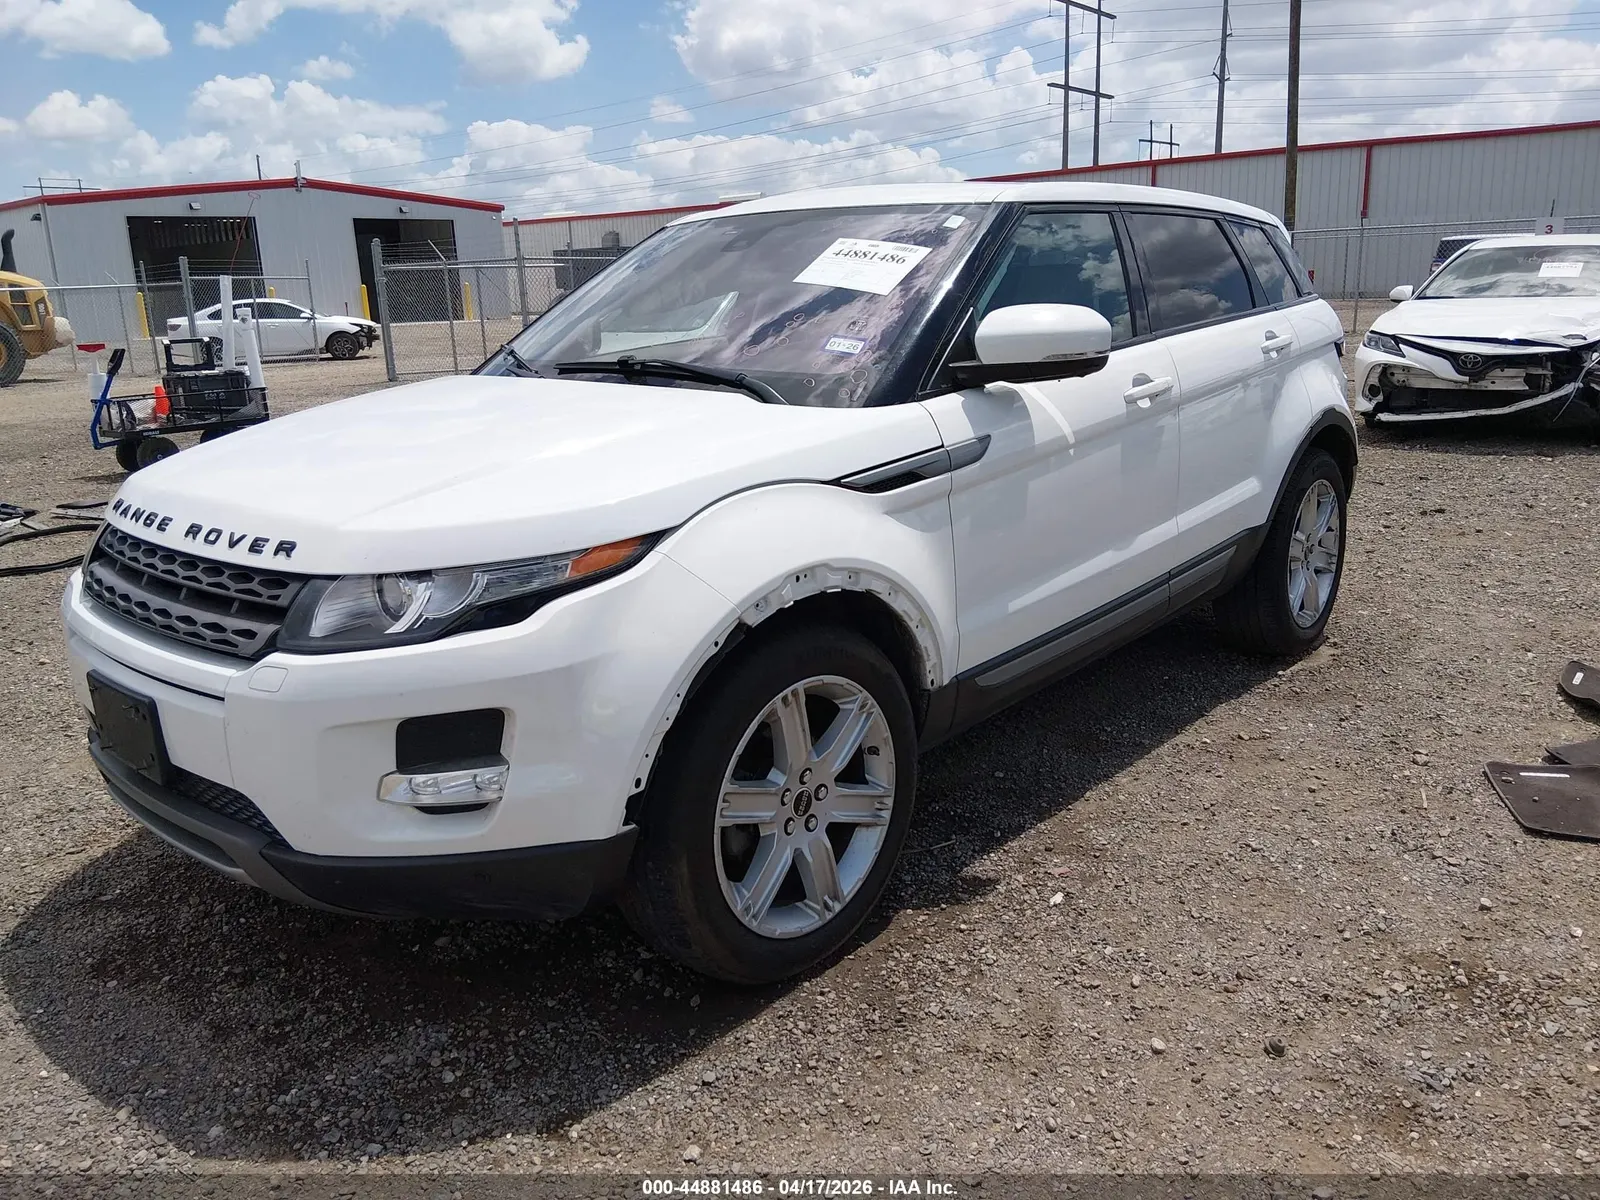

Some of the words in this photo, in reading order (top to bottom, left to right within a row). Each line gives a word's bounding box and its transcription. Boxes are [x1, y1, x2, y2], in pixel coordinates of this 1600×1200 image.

[1545, 224, 1553, 234] 3
[832, 248, 908, 265] 44881486
[112, 498, 173, 533] RANGE
[184, 522, 297, 558] ROVER
